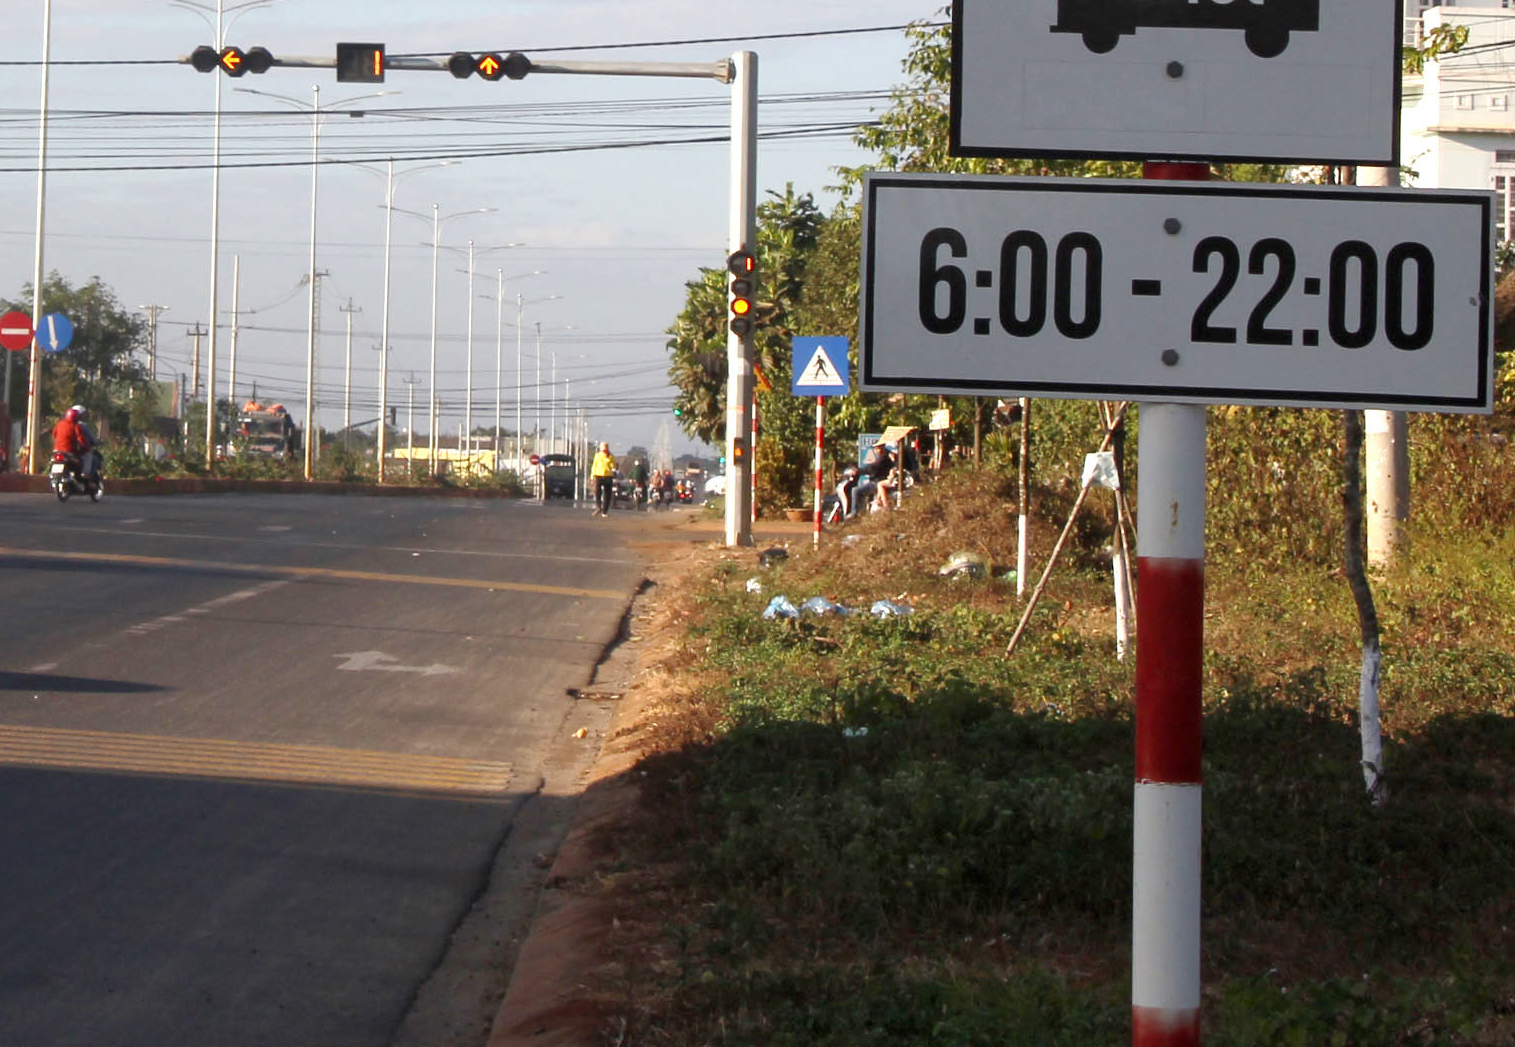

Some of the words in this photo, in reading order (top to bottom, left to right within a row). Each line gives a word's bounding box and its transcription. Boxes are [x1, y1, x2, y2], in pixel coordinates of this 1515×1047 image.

[918, 227, 1103, 340] 6:00
[1131, 278, 1162, 296] -
[1191, 235, 1435, 351] 22:00
